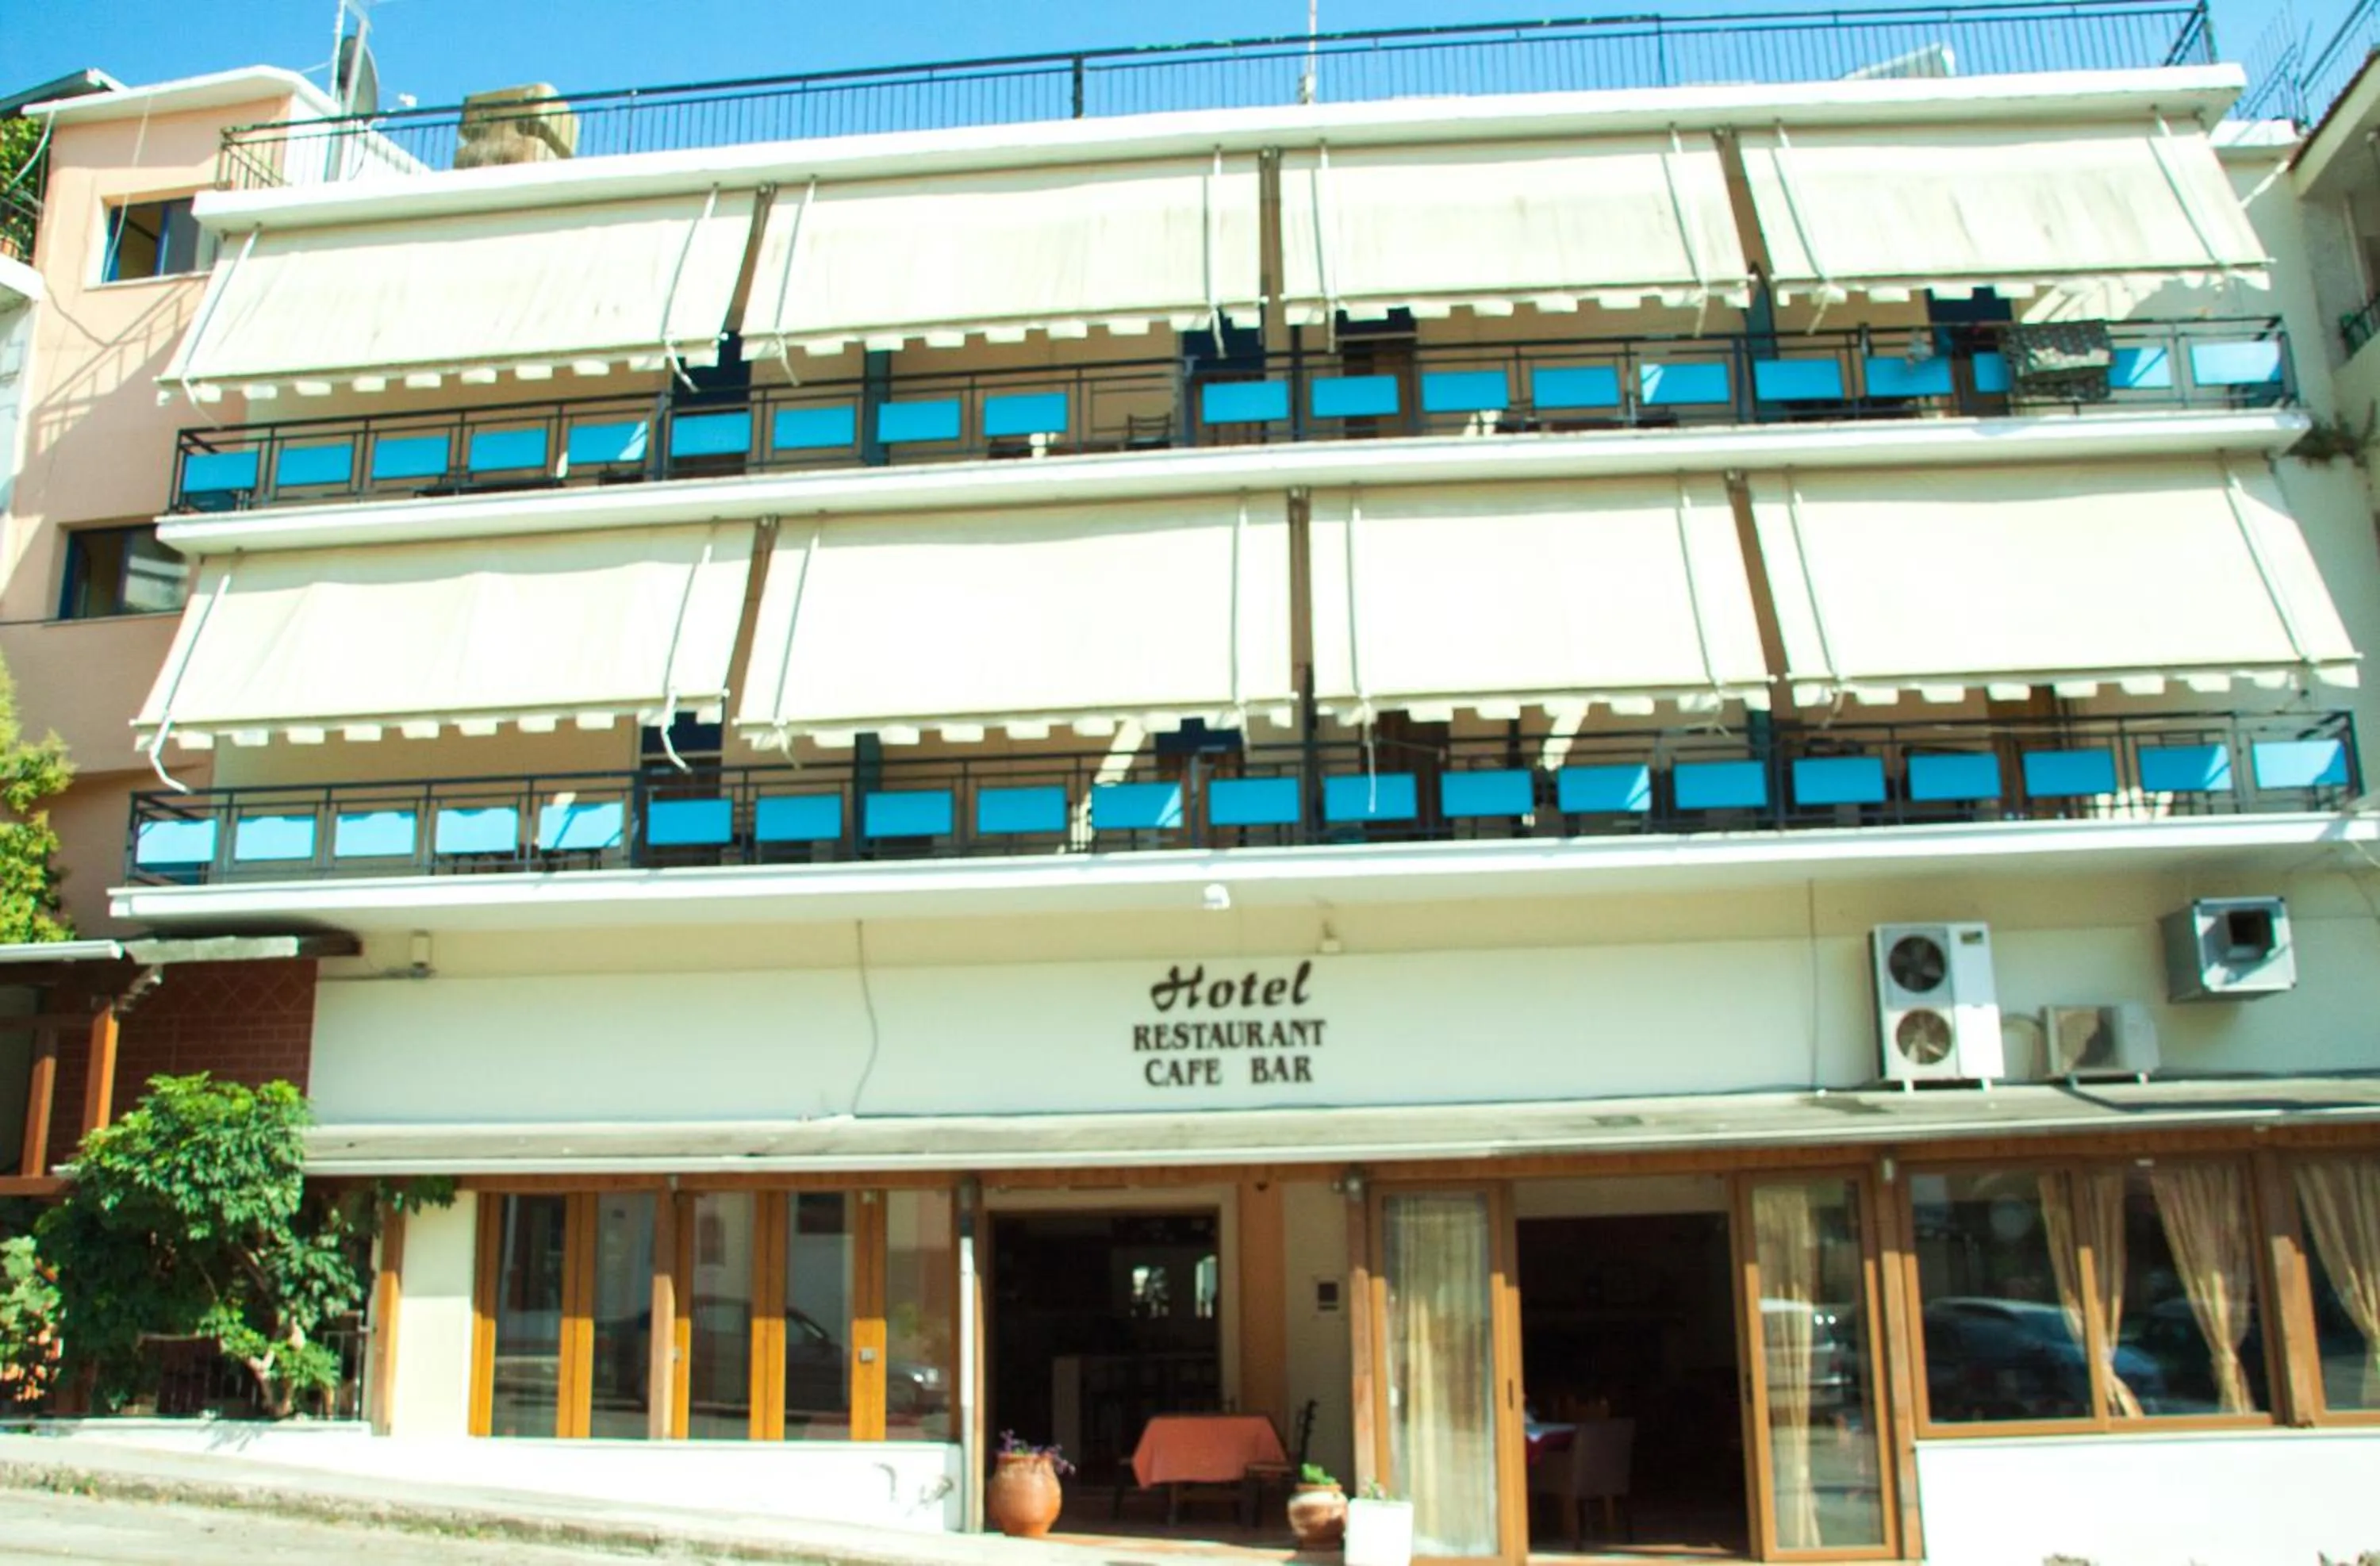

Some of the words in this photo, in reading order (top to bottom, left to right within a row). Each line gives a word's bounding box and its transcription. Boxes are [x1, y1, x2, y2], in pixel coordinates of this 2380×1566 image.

[1150, 959, 1312, 1012] Hotel
[1133, 1019, 1326, 1051] RESTAURANT
[1145, 1057, 1222, 1087] CAFE
[1250, 1055, 1312, 1084] BAR
